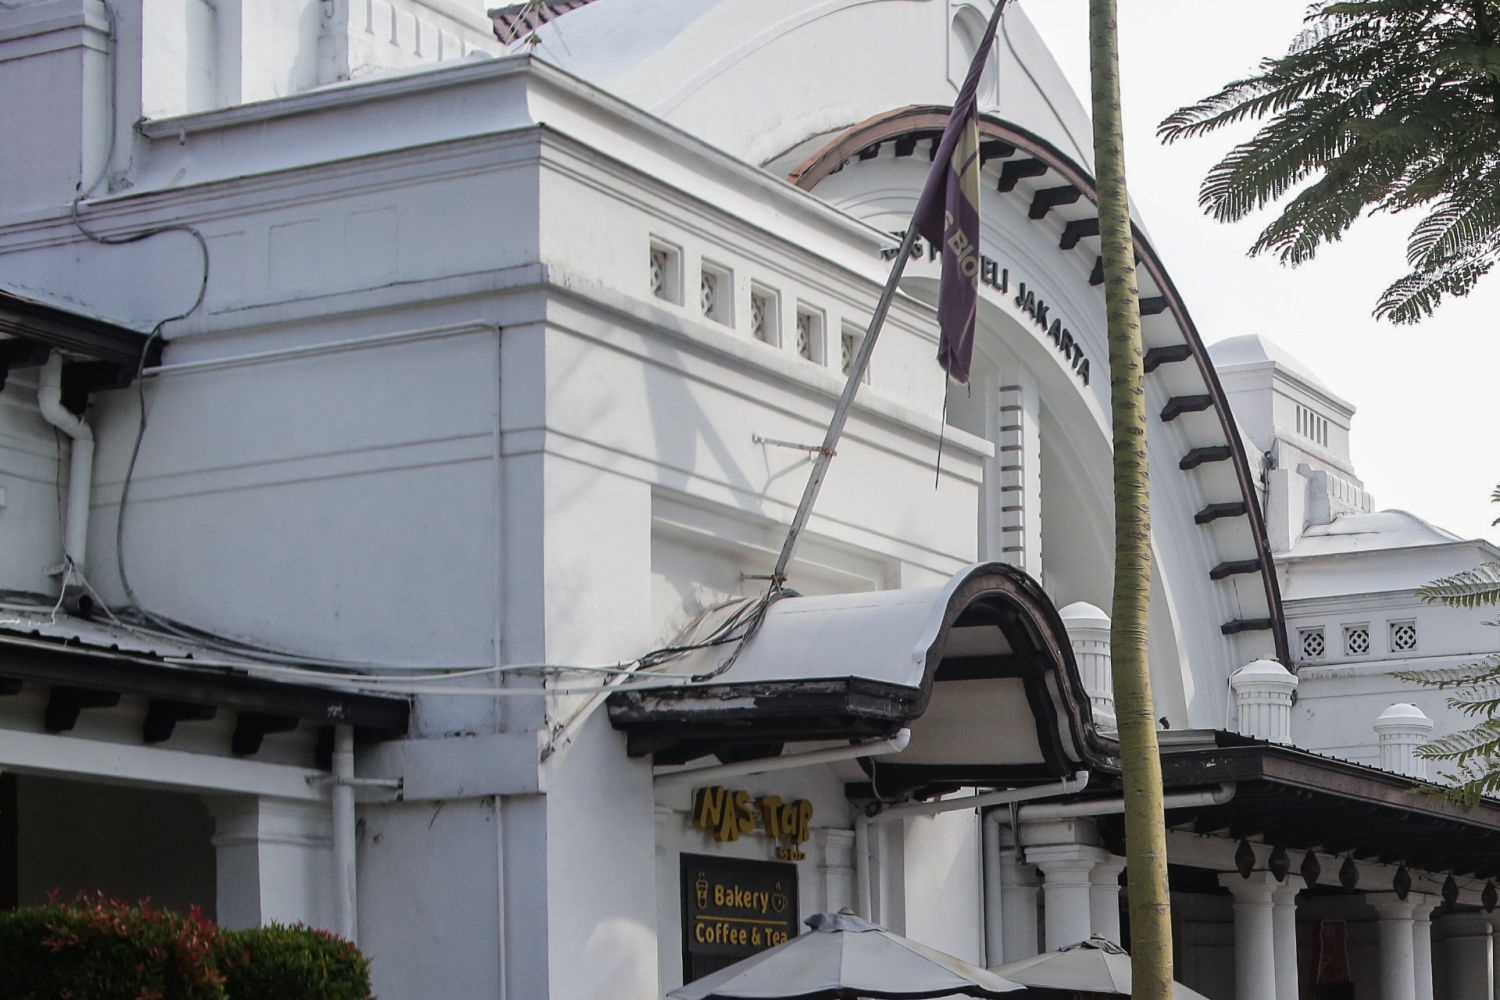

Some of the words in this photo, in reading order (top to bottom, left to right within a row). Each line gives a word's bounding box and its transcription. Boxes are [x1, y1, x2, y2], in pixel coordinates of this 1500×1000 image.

[1015, 282, 1090, 386] JAKARTA
[714, 884, 769, 914] Bakery
[696, 922, 747, 945] Coffee
[751, 927, 761, 945] &
[765, 927, 788, 947] Tea
